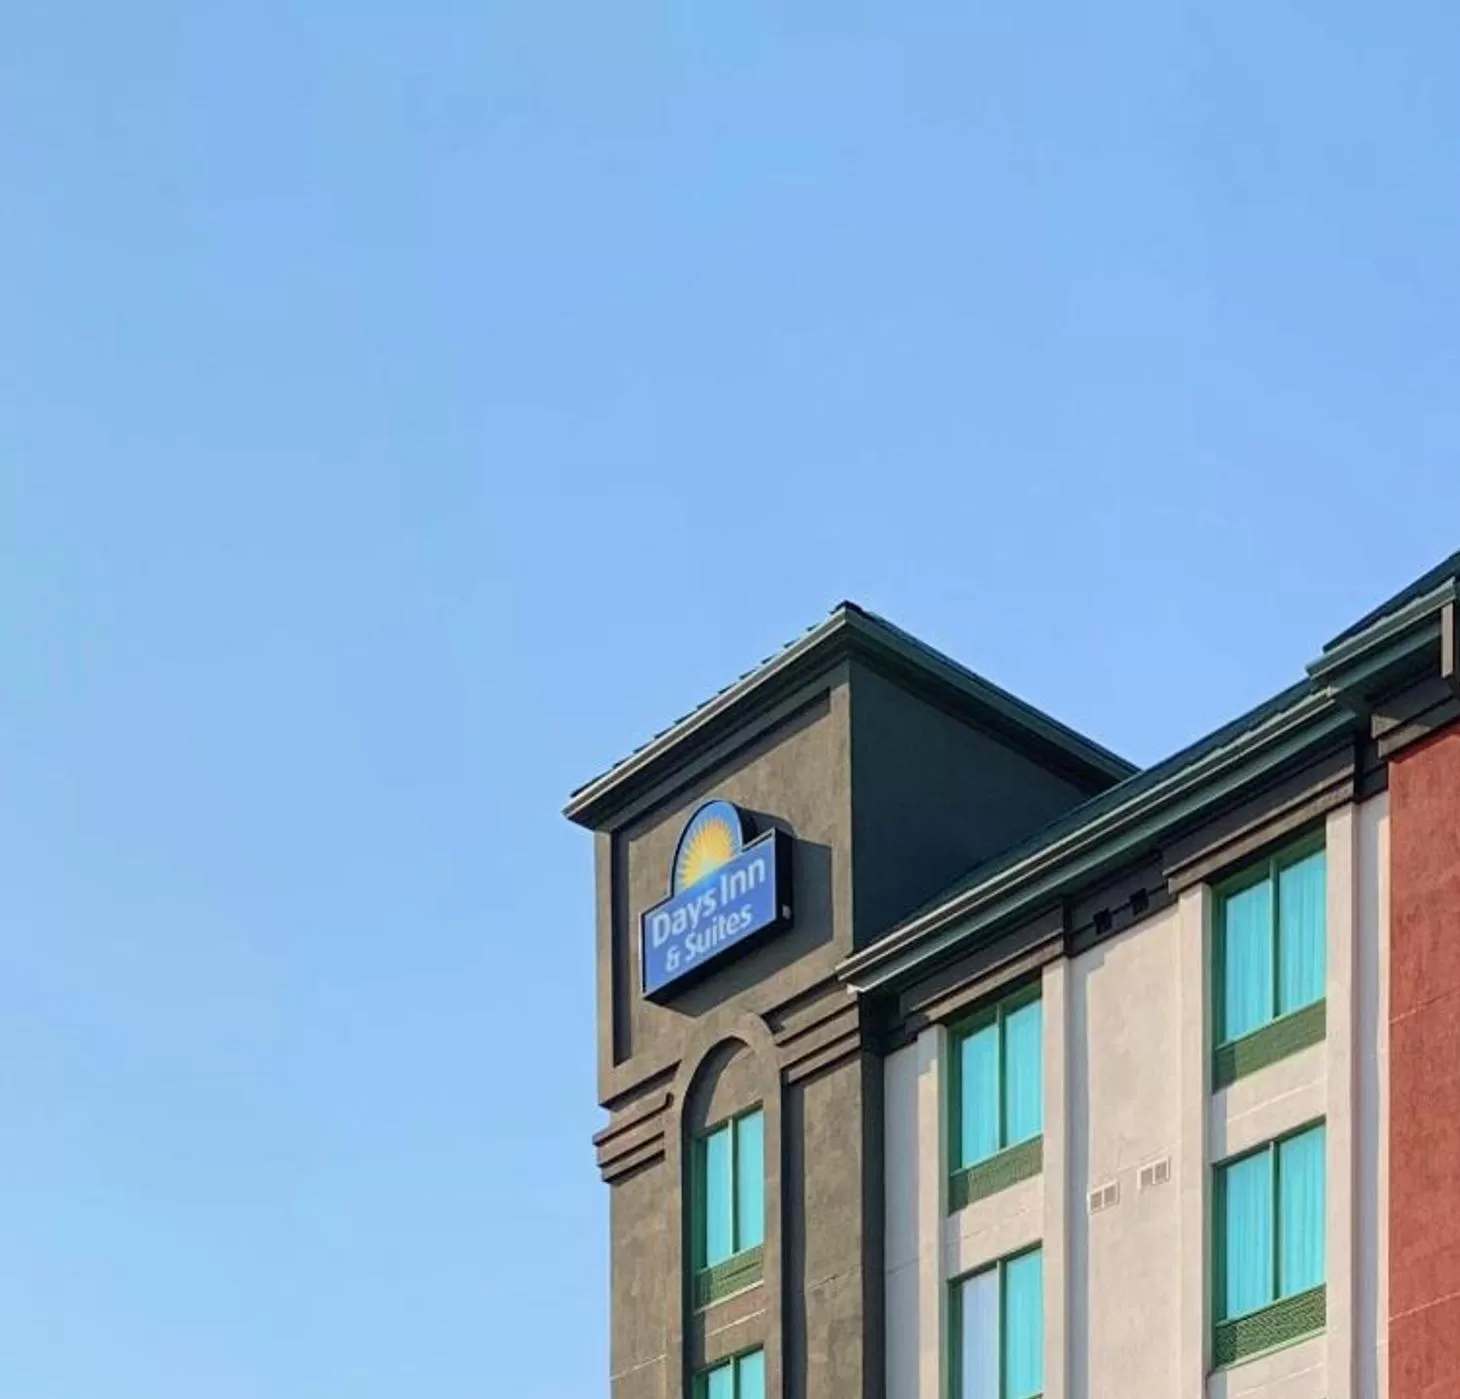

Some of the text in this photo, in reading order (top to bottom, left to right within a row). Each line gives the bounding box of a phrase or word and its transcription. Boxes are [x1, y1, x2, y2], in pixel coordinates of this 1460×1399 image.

[651, 858, 766, 948] Days Inn
[666, 904, 753, 972] & Suites
